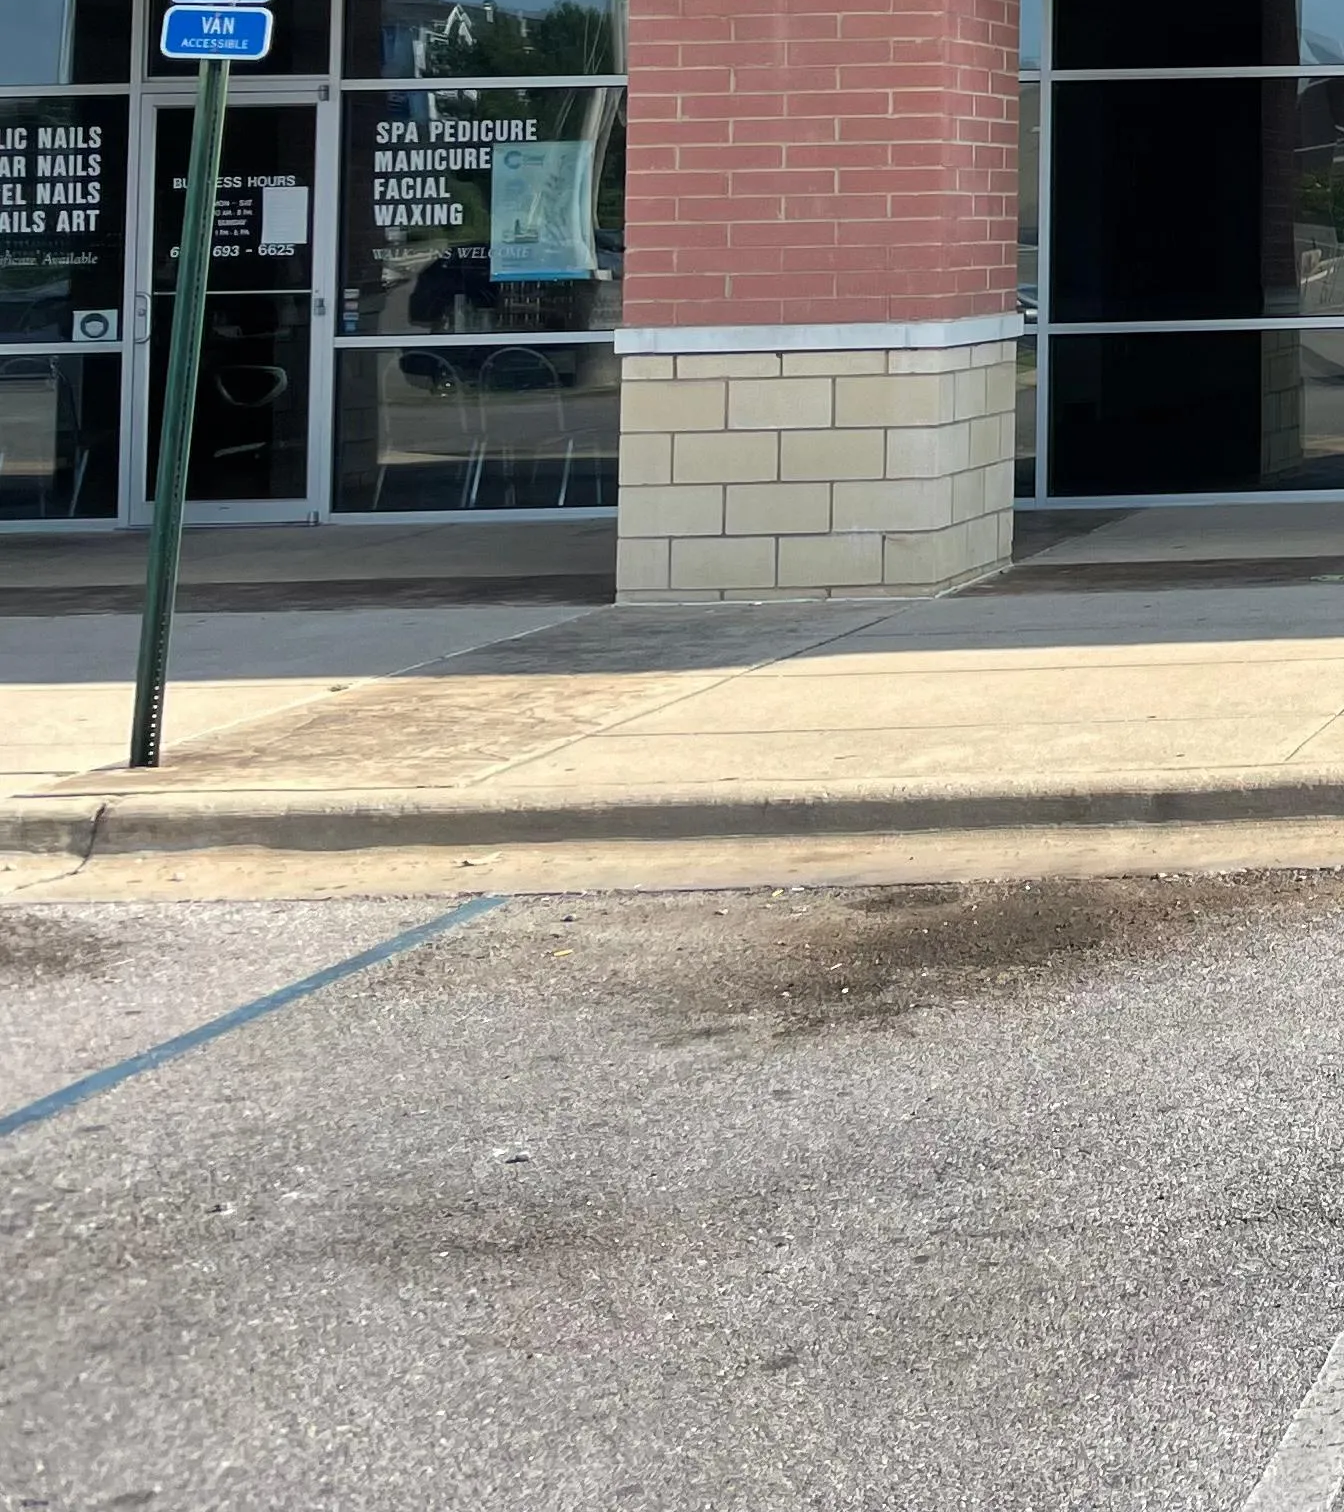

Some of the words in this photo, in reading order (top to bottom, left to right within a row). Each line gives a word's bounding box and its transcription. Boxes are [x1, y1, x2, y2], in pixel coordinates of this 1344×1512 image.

[201, 16, 236, 35] VAN
[180, 37, 250, 50] ACCESSIBLE
[38, 126, 102, 149] NAILS
[375, 121, 419, 144] SPA
[429, 119, 538, 142] PEDICURE
[37, 154, 102, 177] NAILS
[373, 147, 492, 173] MANICURE
[247, 175, 296, 187] HOURS
[373, 177, 451, 201] FACIAL
[36, 181, 101, 205] NAILS
[56, 210, 100, 232] ART
[373, 204, 464, 227] WAXING
[213, 245, 240, 257] 693
[258, 244, 295, 256] 6625
